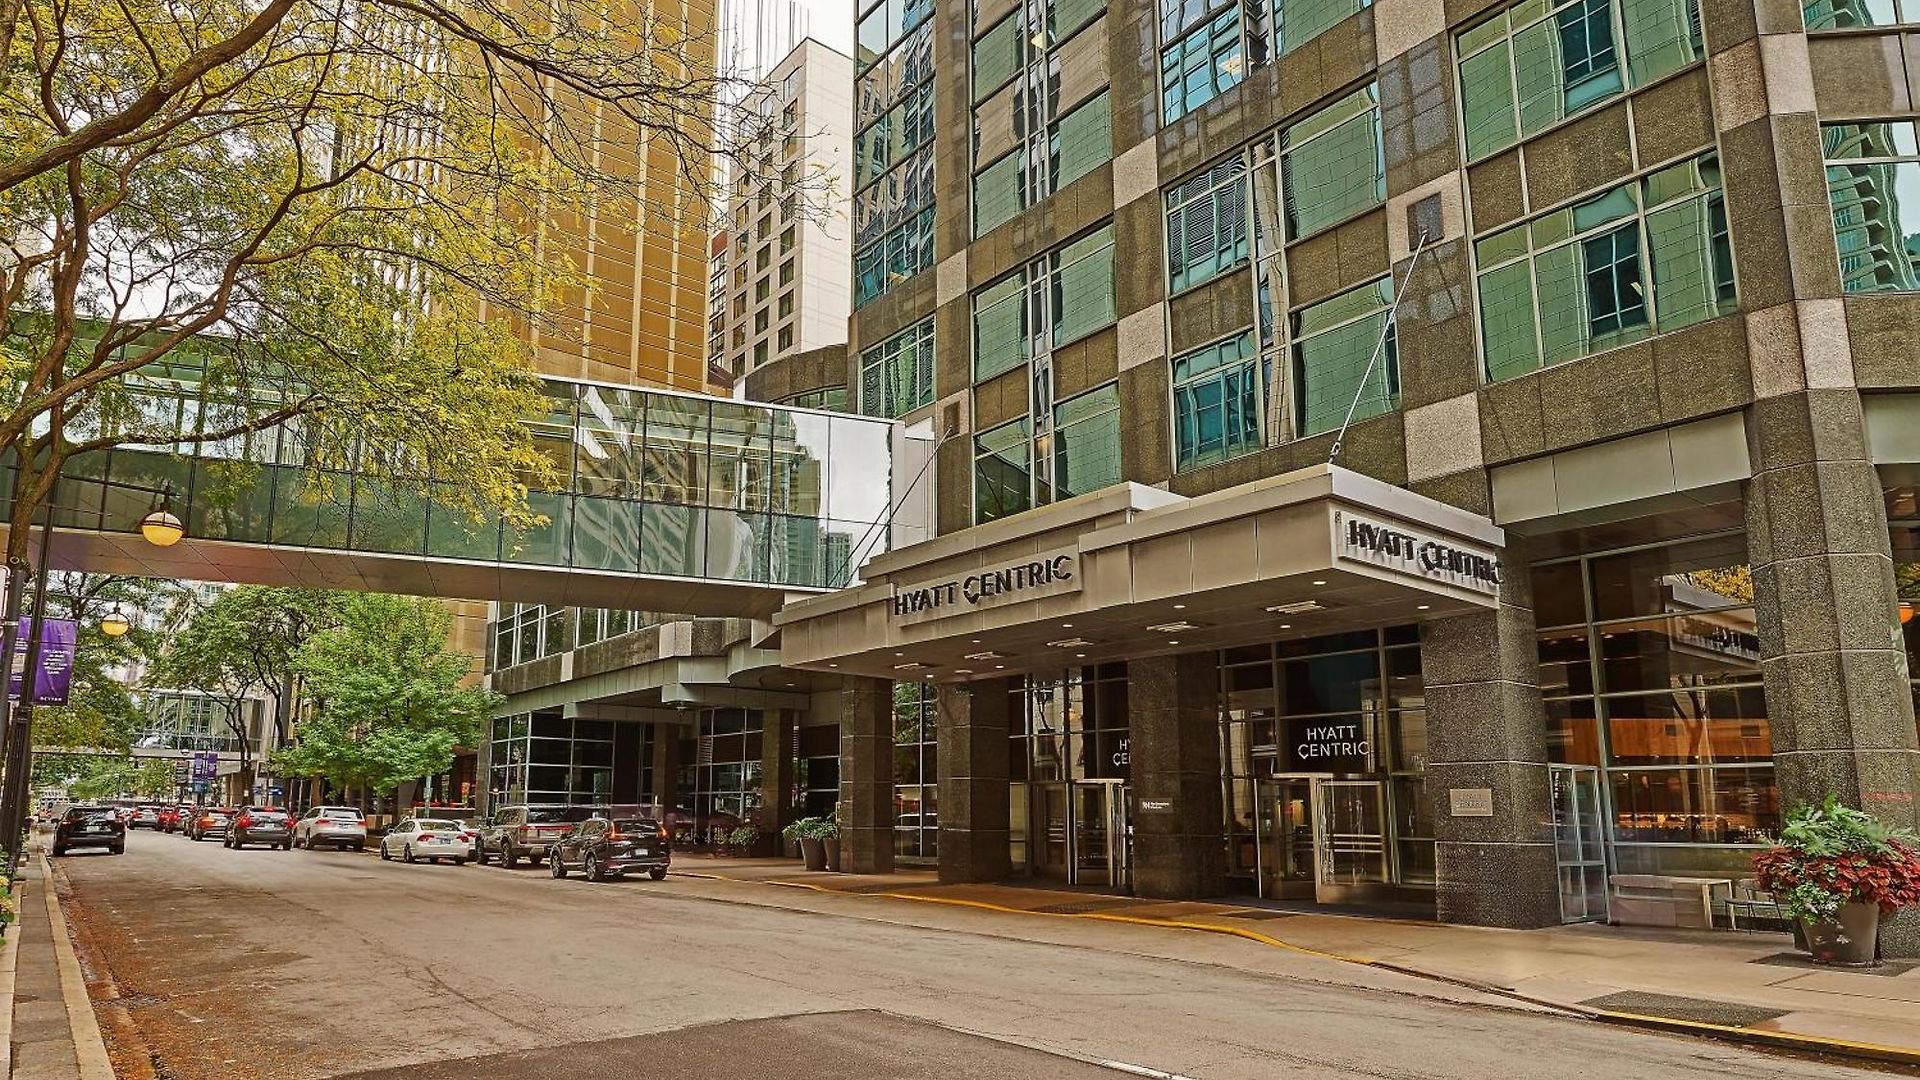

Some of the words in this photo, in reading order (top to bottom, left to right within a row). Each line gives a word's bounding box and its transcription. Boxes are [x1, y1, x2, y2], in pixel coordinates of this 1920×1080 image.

[1345, 520, 1417, 561] HYATT
[894, 581, 959, 616] HYATT
[963, 554, 1073, 604] CENTRIC
[1307, 725, 1357, 741] HYATT
[1298, 741, 1369, 760] CENTRIC
